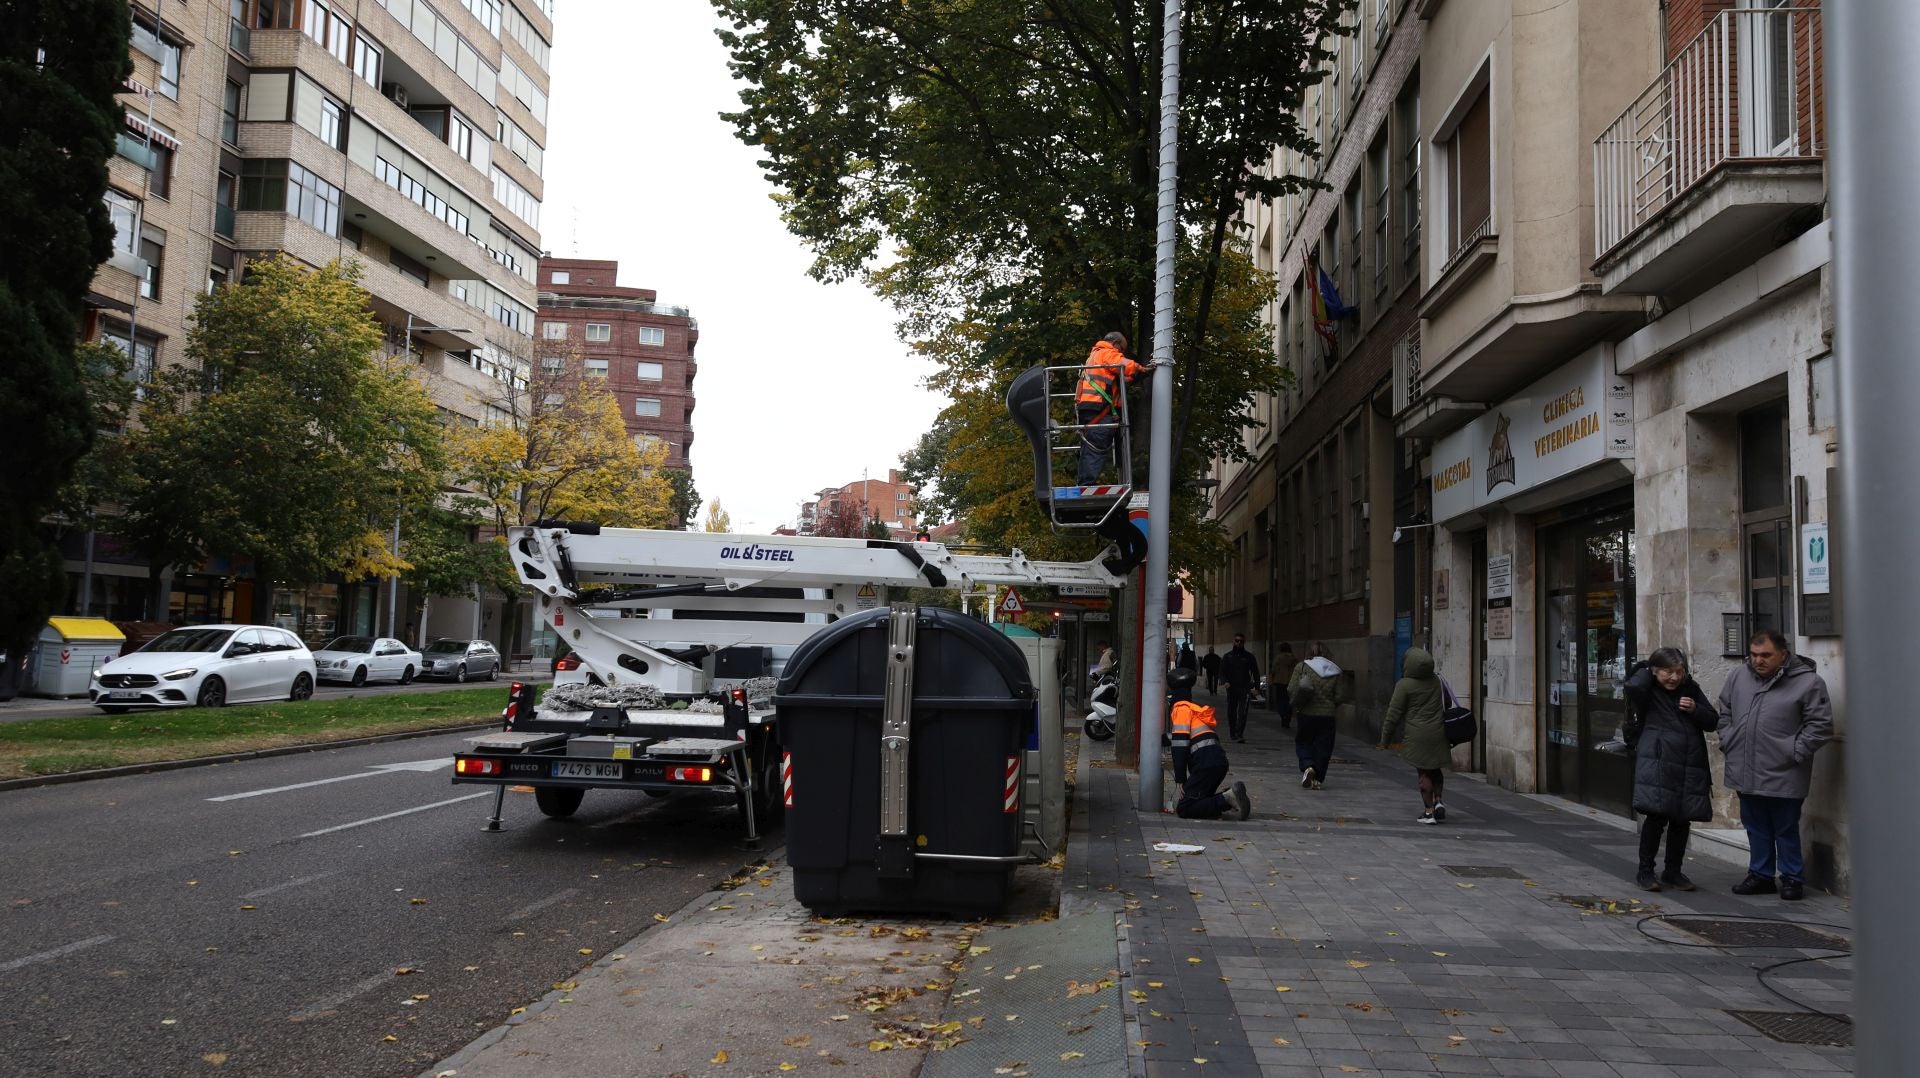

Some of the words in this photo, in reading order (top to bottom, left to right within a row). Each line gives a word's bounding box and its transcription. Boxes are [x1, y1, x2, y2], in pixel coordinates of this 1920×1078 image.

[1534, 412, 1600, 458] VETERINARIA
[1433, 457, 1471, 493] MASCOTAS
[510, 763, 539, 771] IVECO
[560, 763, 592, 776] 7476
[596, 763, 620, 777] MGM
[634, 767, 664, 775] DAILY
